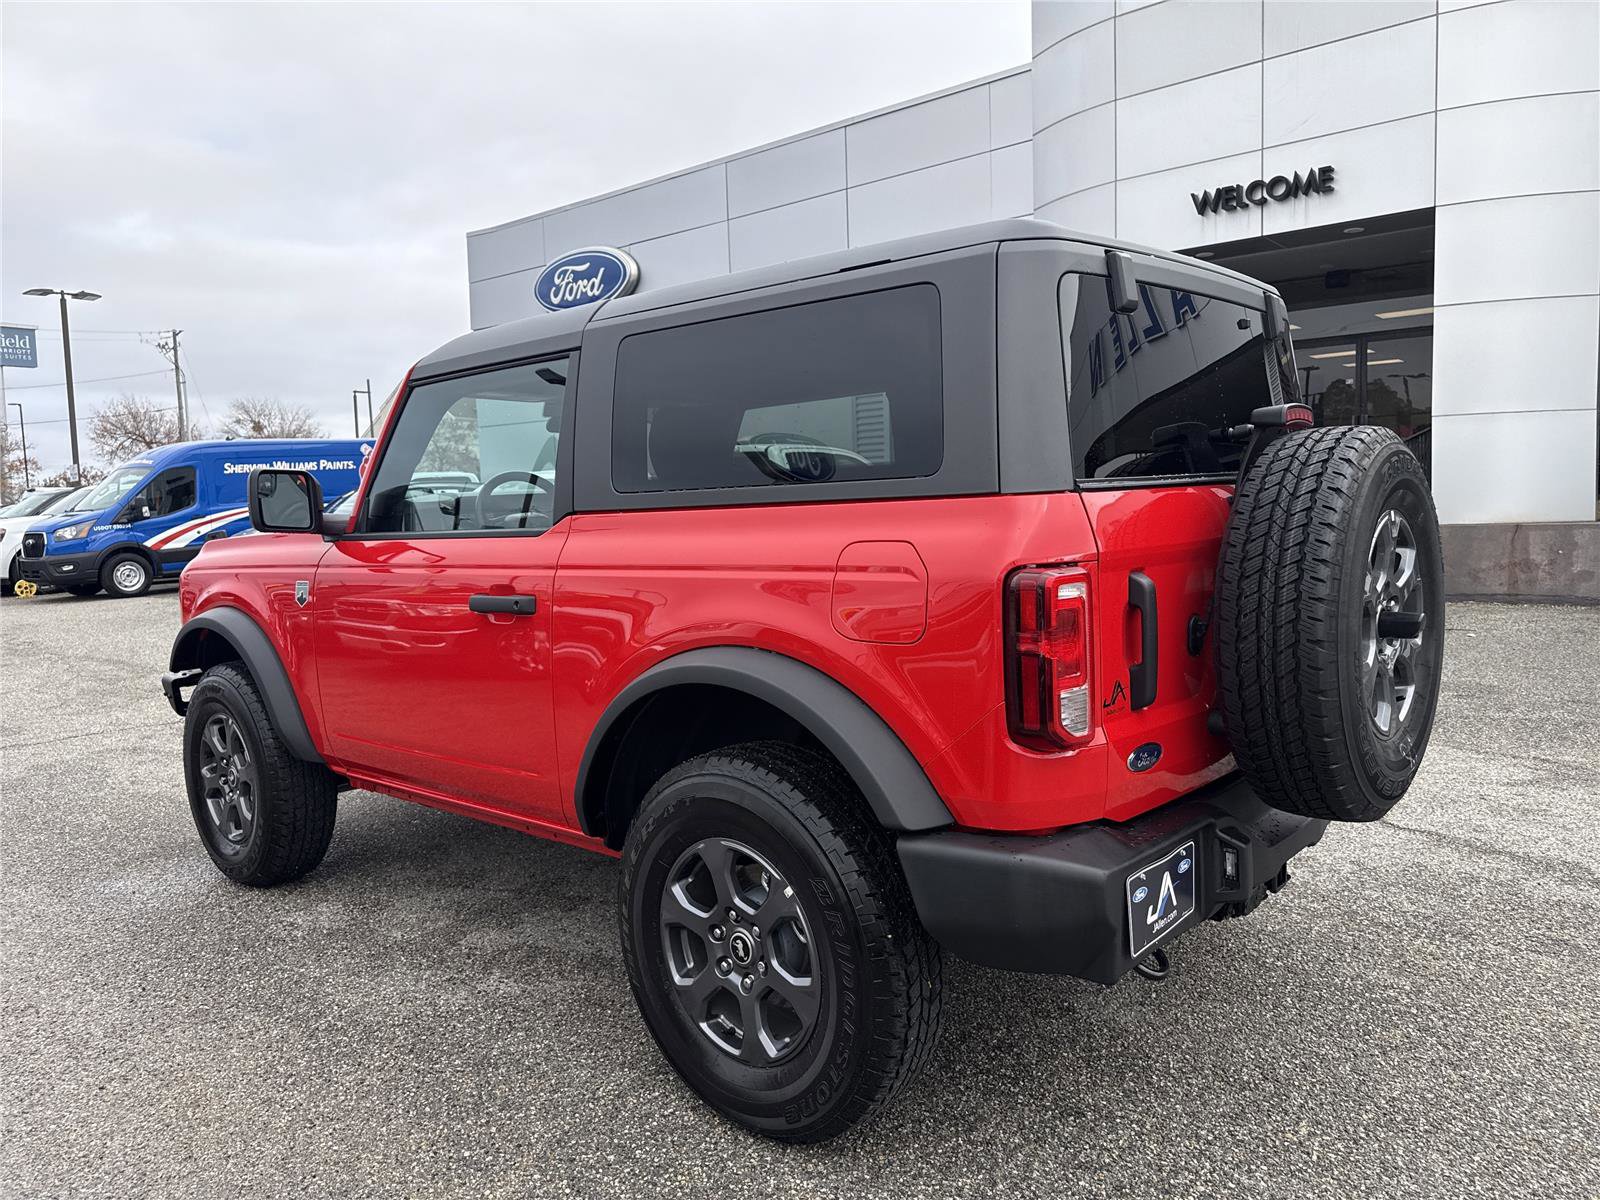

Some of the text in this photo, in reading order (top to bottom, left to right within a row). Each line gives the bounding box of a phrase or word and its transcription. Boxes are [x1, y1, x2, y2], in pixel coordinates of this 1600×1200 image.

[1190, 165, 1335, 217] WELCOME
[550, 262, 606, 305] Ford
[0, 334, 30, 349] ield
